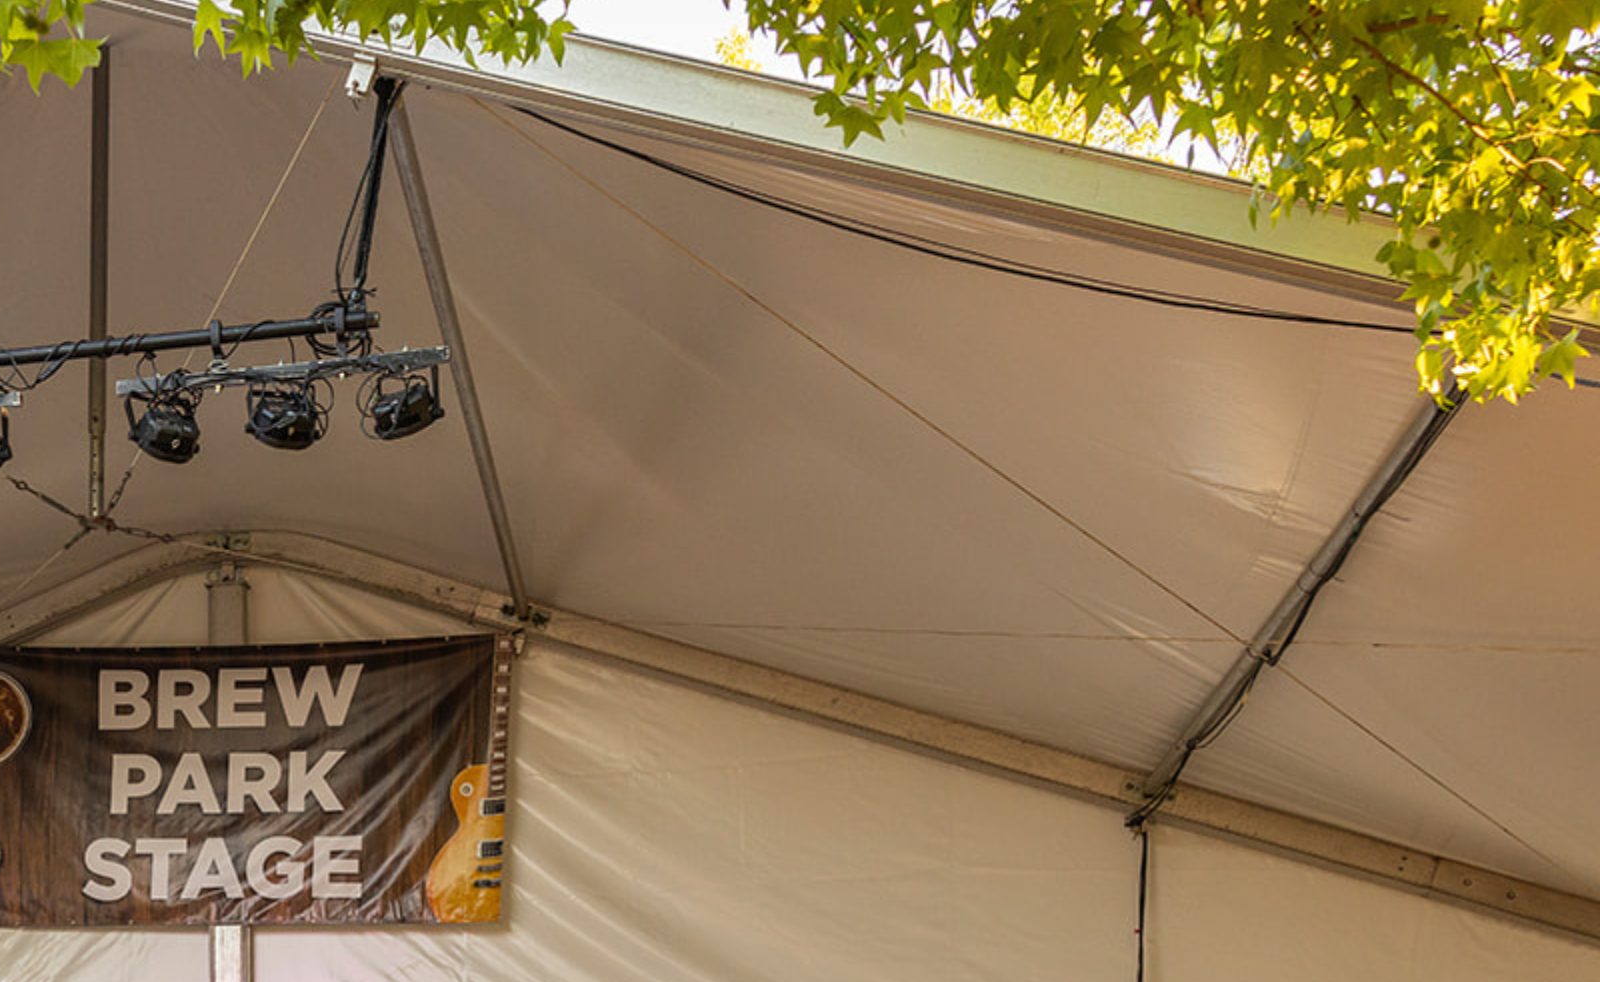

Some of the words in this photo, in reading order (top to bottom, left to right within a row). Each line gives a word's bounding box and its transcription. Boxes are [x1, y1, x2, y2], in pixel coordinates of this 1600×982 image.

[98, 663, 365, 731] BREW
[110, 749, 347, 815] PARK
[82, 835, 363, 902] STAGE
